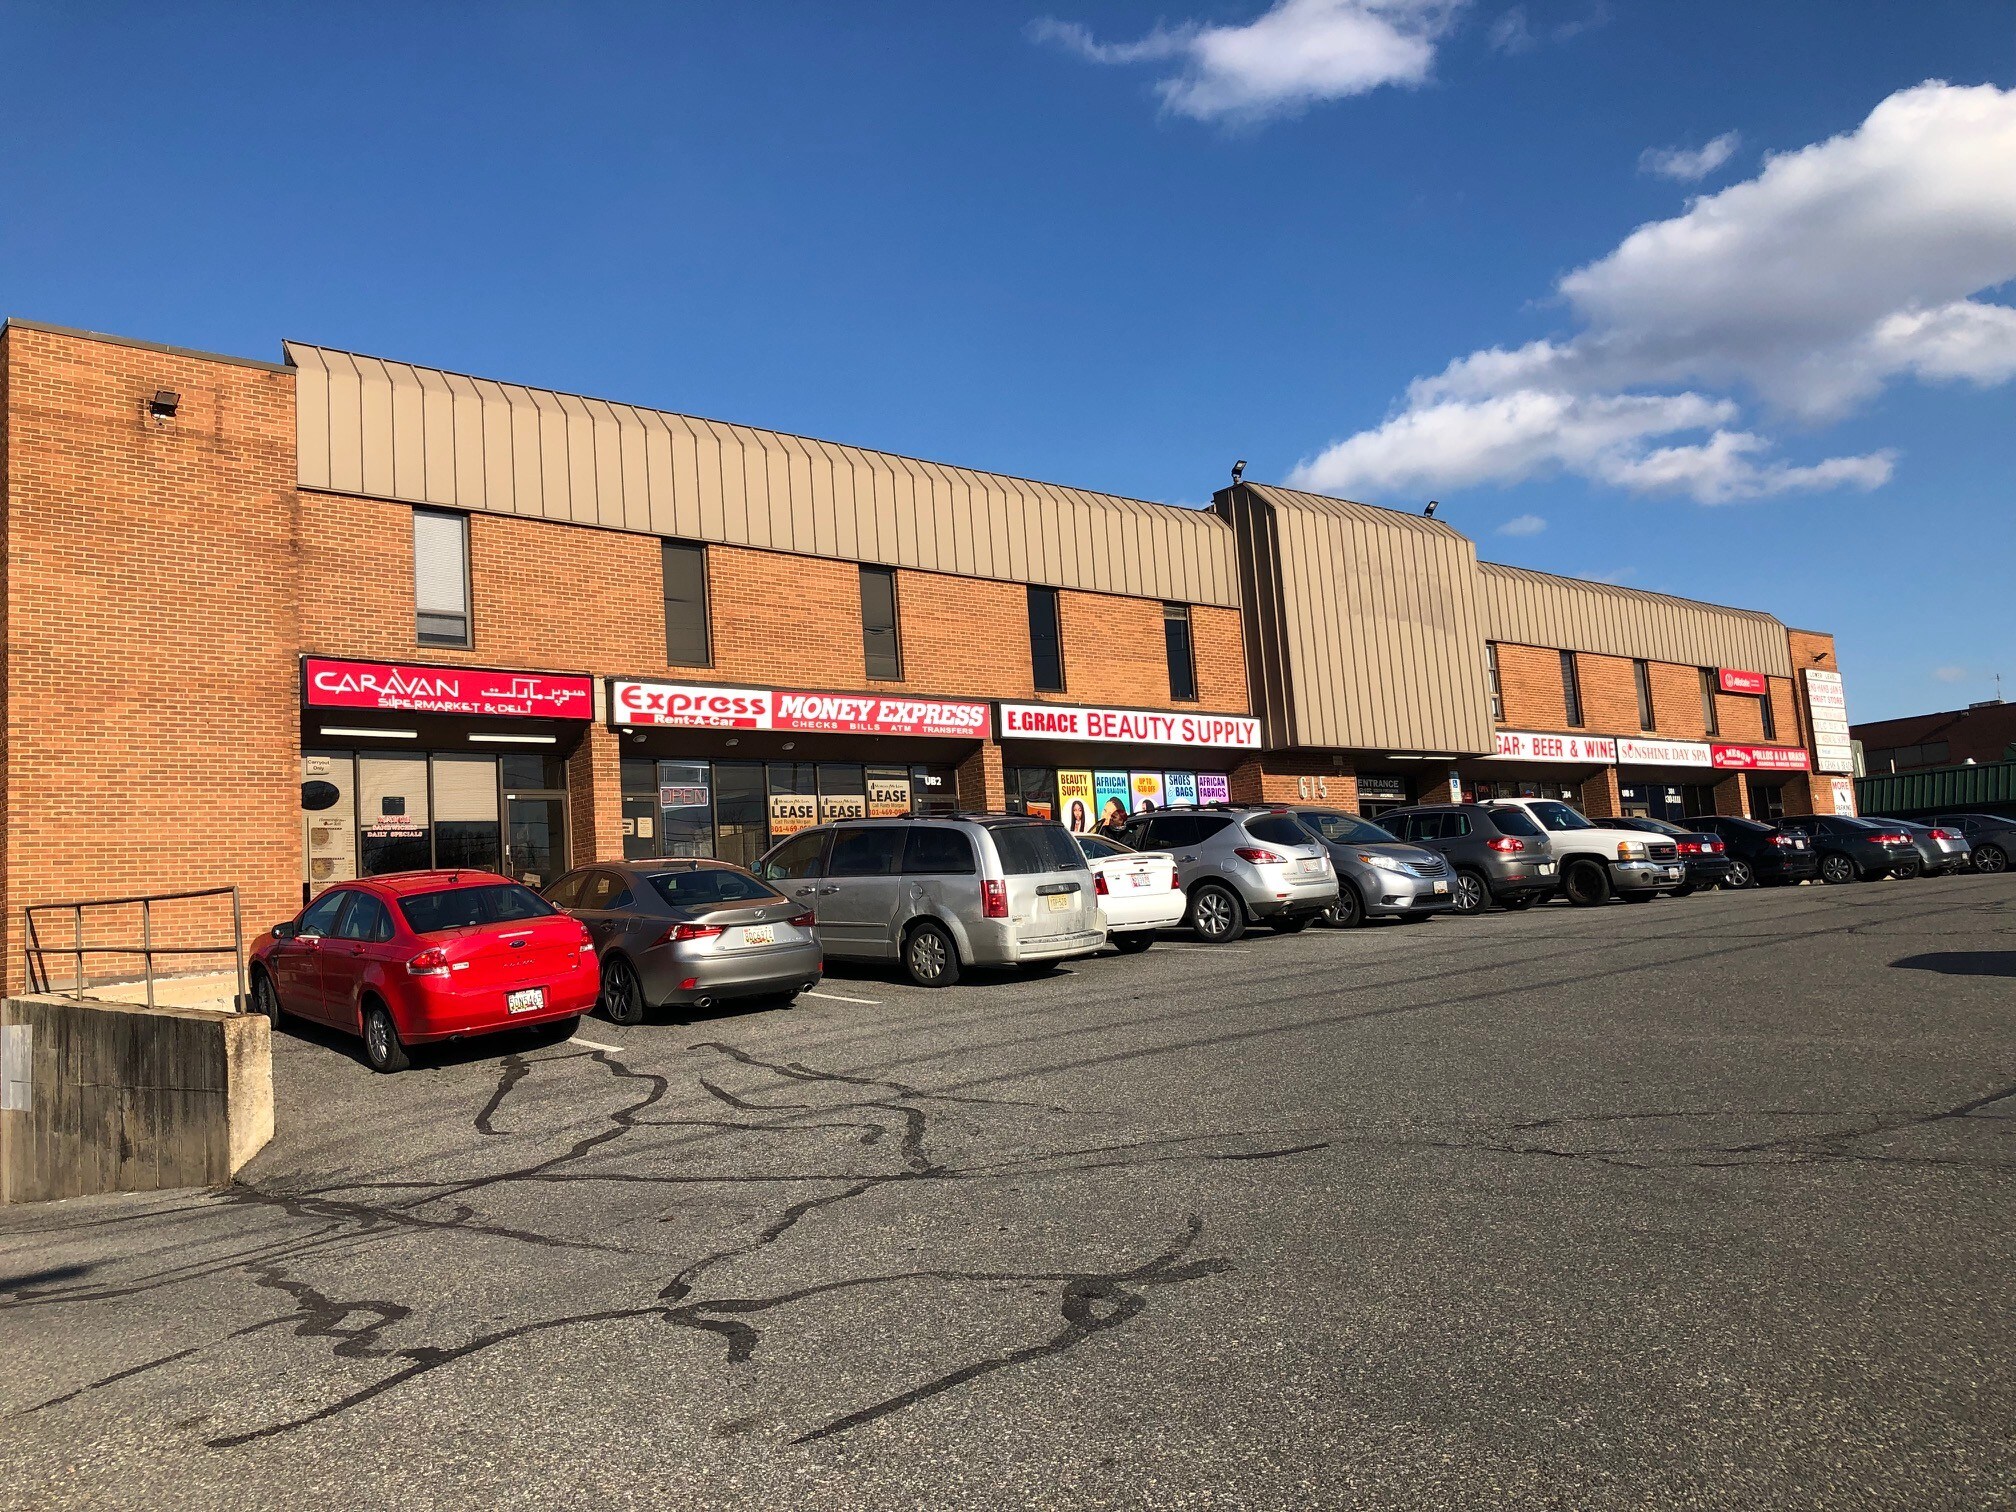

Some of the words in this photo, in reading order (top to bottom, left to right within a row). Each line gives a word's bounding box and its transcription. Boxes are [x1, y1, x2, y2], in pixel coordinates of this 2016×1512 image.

[314, 668, 459, 699] CARAVAN
[378, 696, 481, 713] SUPERMARKET
[484, 703, 497, 714] &
[498, 700, 533, 714] DELI
[621, 685, 766, 717] Express
[1809, 694, 1827, 704] THRIFT
[1827, 695, 1843, 706] STORE
[777, 695, 876, 721] MONEY
[877, 699, 985, 727] EXPRESS
[653, 713, 735, 726] Rent-A-Car
[792, 721, 838, 730] CHECKS
[850, 723, 880, 731] BILLS
[890, 724, 912, 732] ATM
[922, 725, 975, 735] TRANSFERS
[1008, 711, 1078, 733] E.GRACE
[1087, 712, 1176, 741] BEAUTY
[1182, 718, 1255, 745] SUPPLY
[1533, 737, 1563, 757] BEER
[1570, 740, 1579, 758] &
[1584, 740, 1615, 759] WINE
[1621, 743, 1669, 760] SUNSHINE
[1673, 748, 1689, 761] DAY
[1692, 750, 1708, 762] SPA
[1752, 750, 1774, 760] POLLOS
[1774, 751, 1779, 761] A
[1779, 751, 1788, 761] LA
[1787, 752, 1807, 762] BRASA
[308, 759, 330, 767] Carryout
[924, 777, 942, 786] UB2
[1060, 774, 1088, 785] BEAUTY
[1096, 776, 1127, 787] AFRICAN
[1169, 774, 1191, 785] SHOES
[1199, 776, 1226, 787] AFRICAN
[1358, 779, 1399, 788] ENTRANCE
[1832, 781, 1849, 790] MORE
[1061, 786, 1089, 797] SUPPLY
[1176, 787, 1194, 797] BAGS
[1199, 787, 1227, 798] FABRICS
[1298, 775, 1327, 800] 615
[661, 788, 707, 804] OPEN
[869, 790, 907, 803] LEASE
[771, 805, 814, 819] LEASE
[822, 805, 862, 818] LEASE
